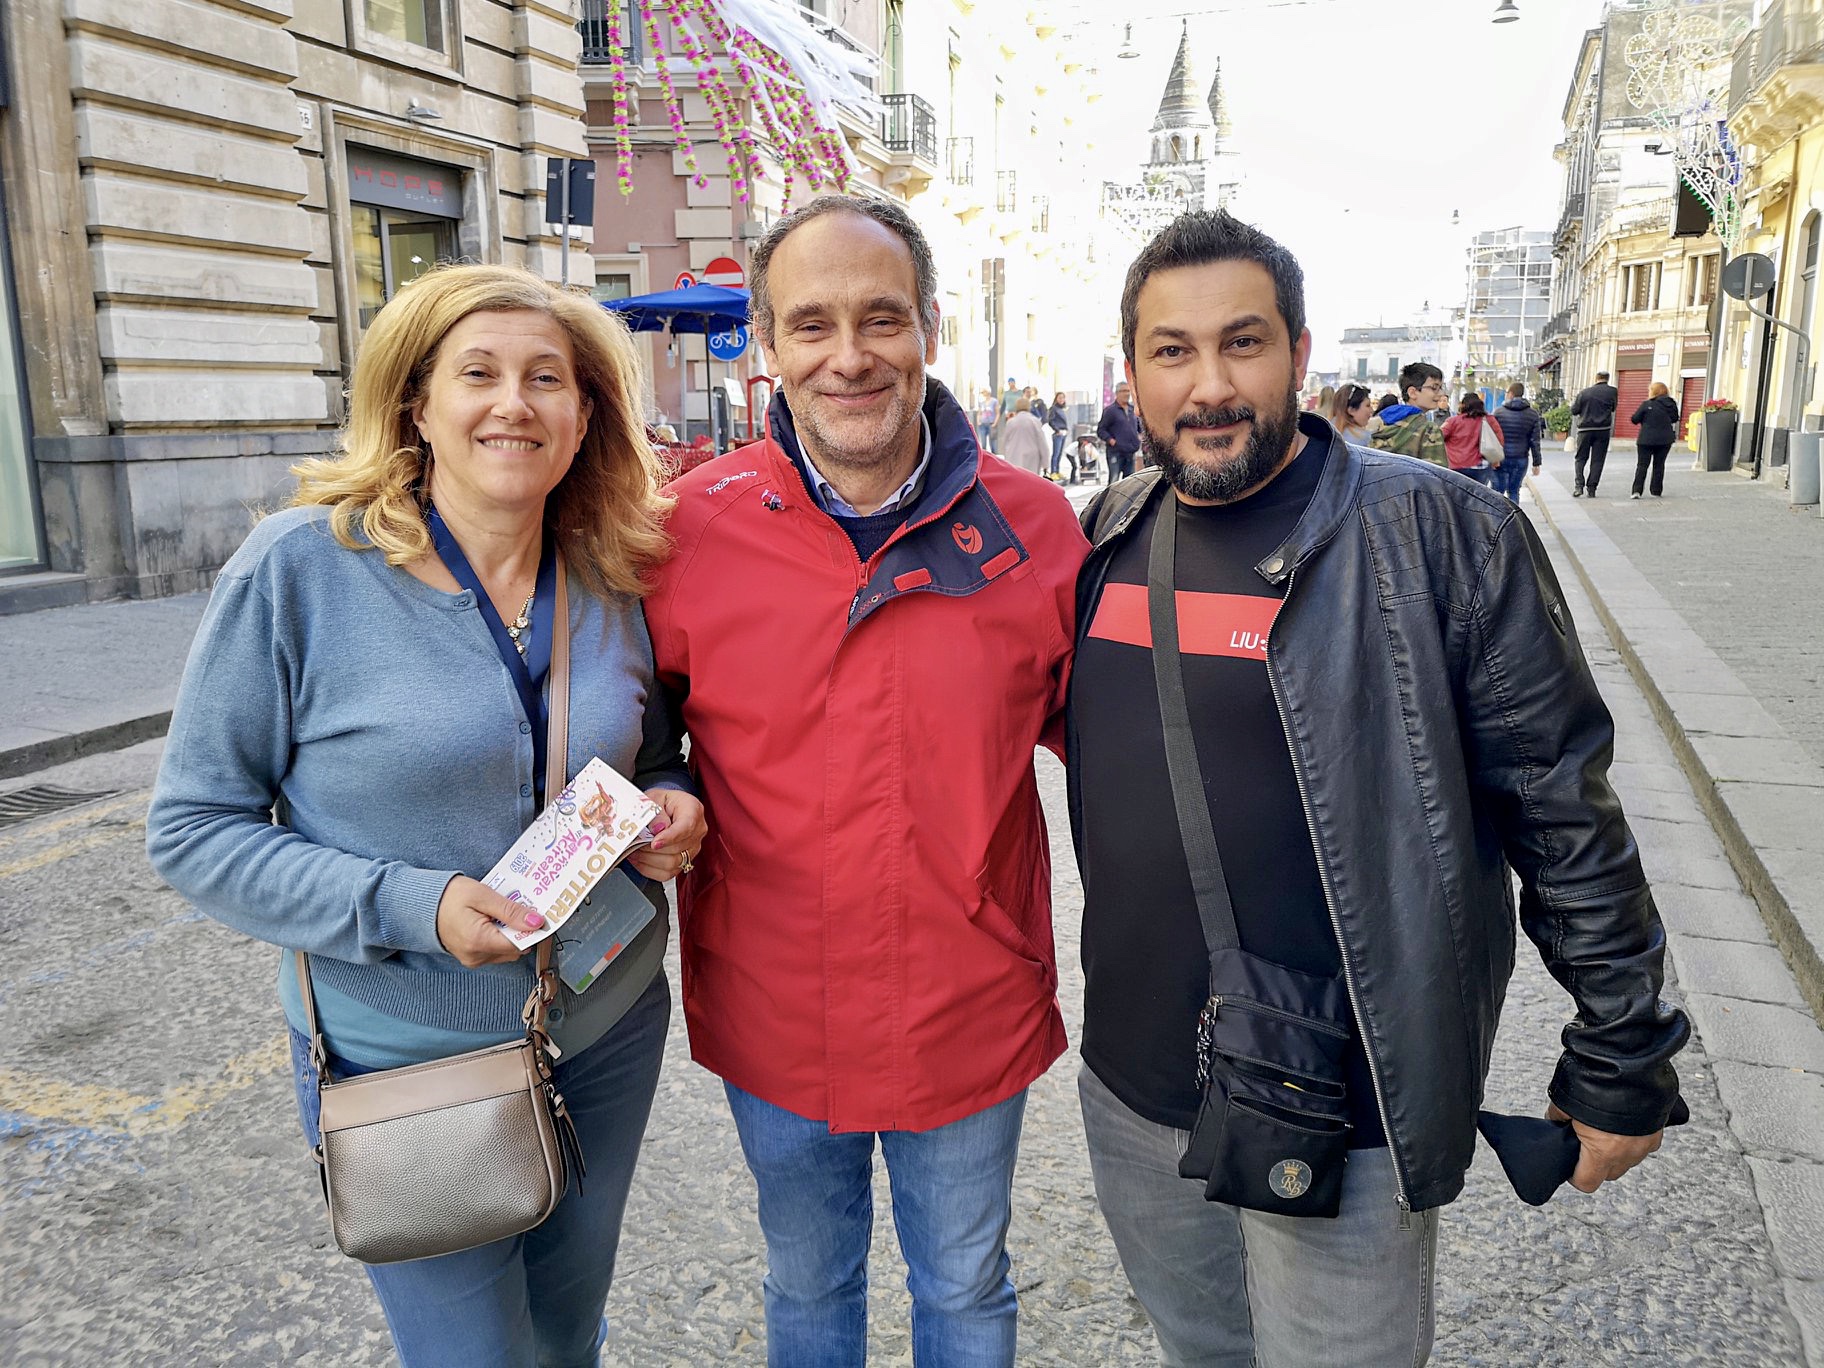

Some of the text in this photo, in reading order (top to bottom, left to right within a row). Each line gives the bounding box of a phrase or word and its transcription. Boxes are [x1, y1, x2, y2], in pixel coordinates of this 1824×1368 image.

[353, 165, 444, 197] HOPE
[509, 852, 528, 874] 2019
[532, 828, 577, 881] Acireale
[533, 834, 594, 896] Carnevale
